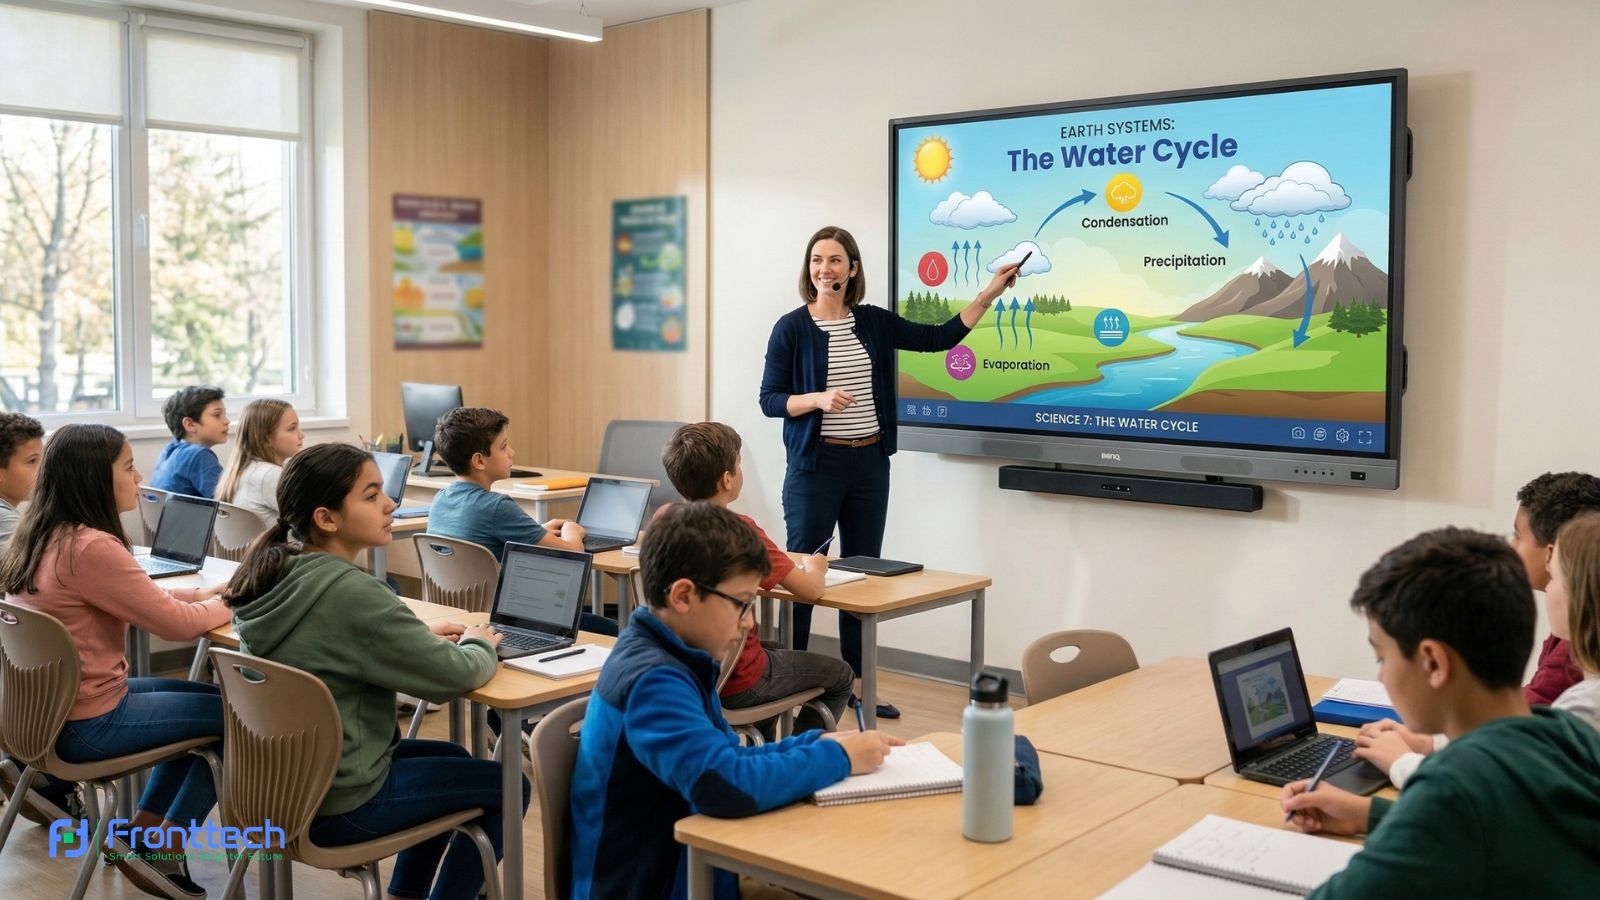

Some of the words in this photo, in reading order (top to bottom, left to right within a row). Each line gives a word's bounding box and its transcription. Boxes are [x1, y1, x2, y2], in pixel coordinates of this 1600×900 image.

[1061, 124, 1103, 139] EARTH
[1107, 118, 1175, 135] SYSTEMS:
[1007, 148, 1054, 172] The
[1061, 142, 1146, 168] Water
[1152, 133, 1238, 169] Cycle
[1081, 214, 1169, 229] Condensation
[1143, 254, 1226, 270] Precipitation
[983, 359, 1050, 372] Evaporation
[1035, 412, 1080, 425] SCIENCE
[1083, 414, 1093, 426] 7:
[1095, 416, 1115, 427] THE
[1117, 417, 1158, 430] WATER
[1160, 420, 1199, 433] CYCLE
